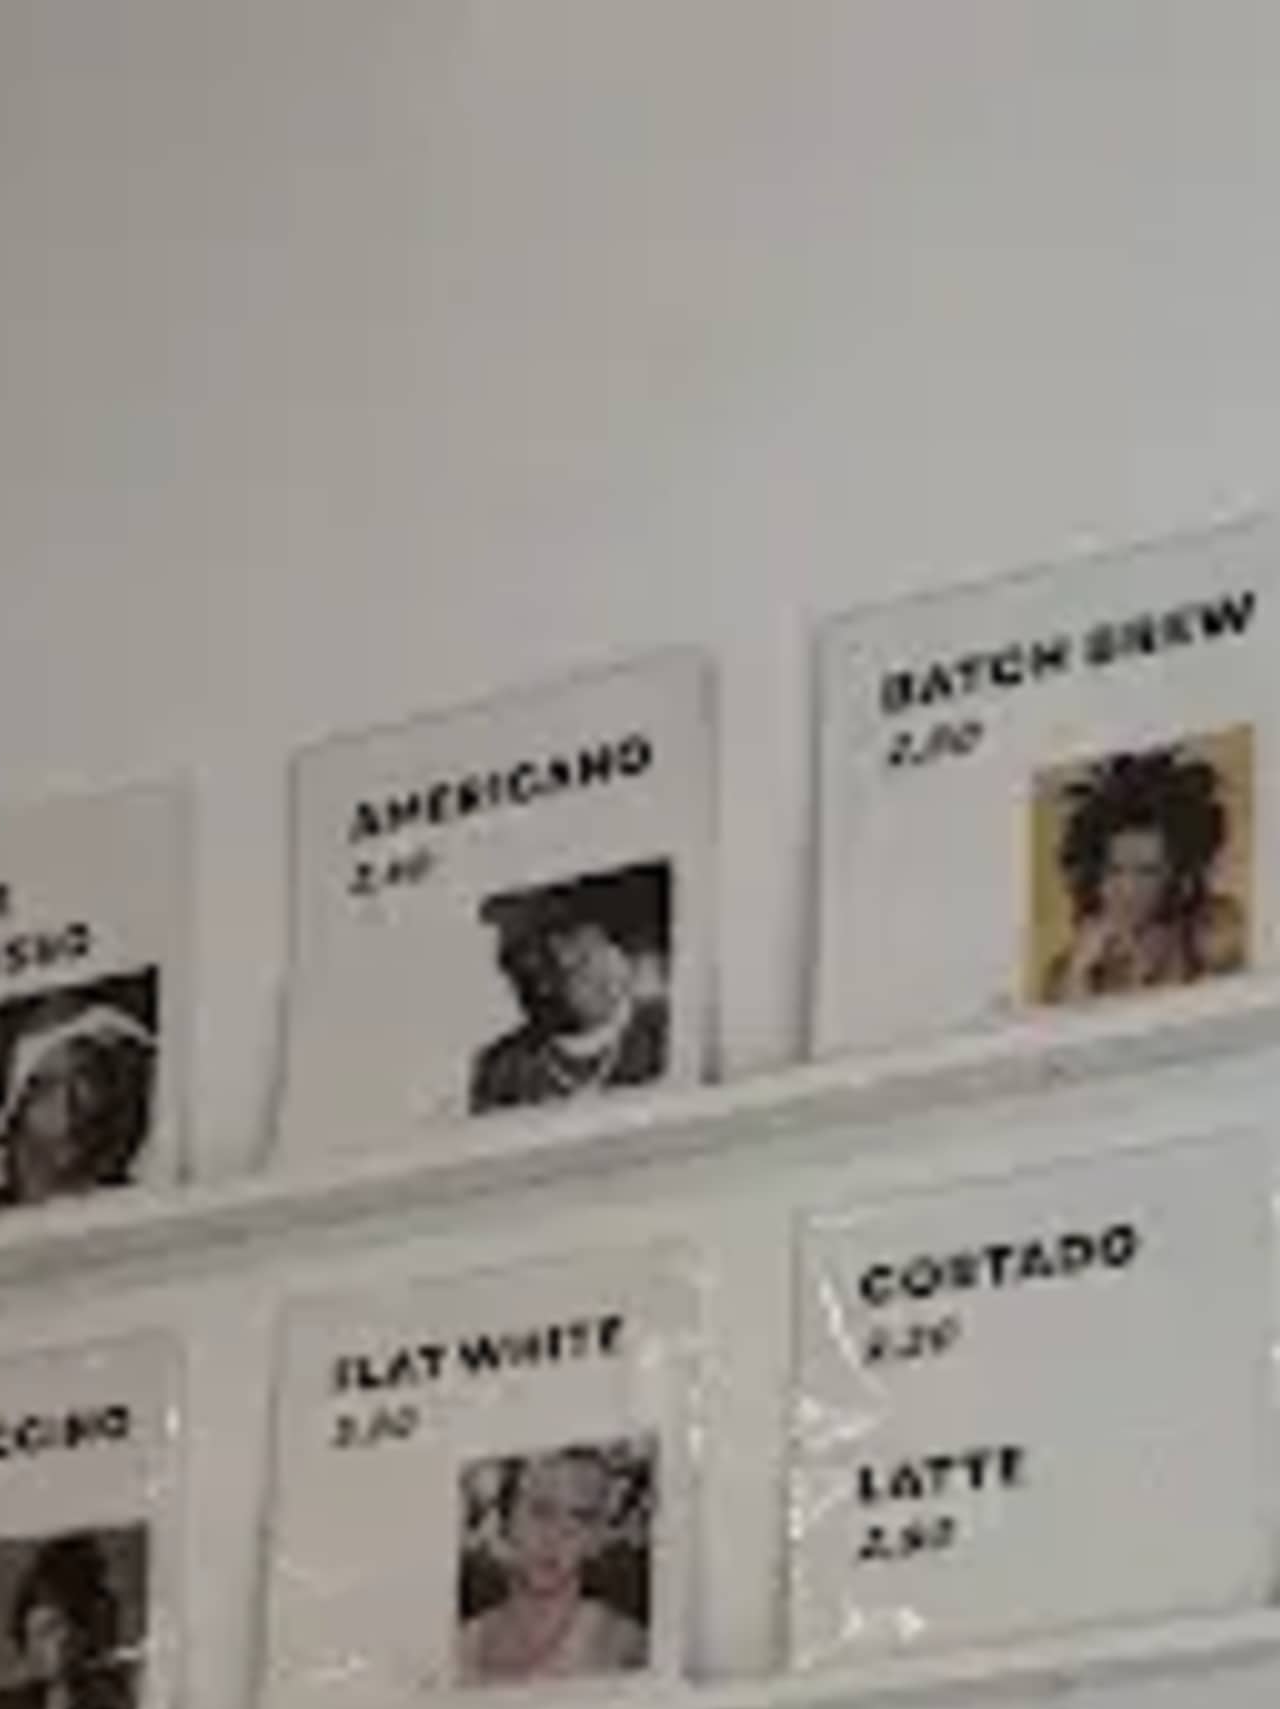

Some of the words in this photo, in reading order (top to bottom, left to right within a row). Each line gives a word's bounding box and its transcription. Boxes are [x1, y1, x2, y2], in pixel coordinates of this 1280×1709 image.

[880, 640, 1070, 715] BATCH
[350, 734, 653, 843] AMERICANO
[858, 1223, 1139, 1307] CORTADO
[335, 1344, 447, 1391] FLAT
[458, 1314, 623, 1374] WHITE
[857, 1445, 1023, 1505] LATTE
